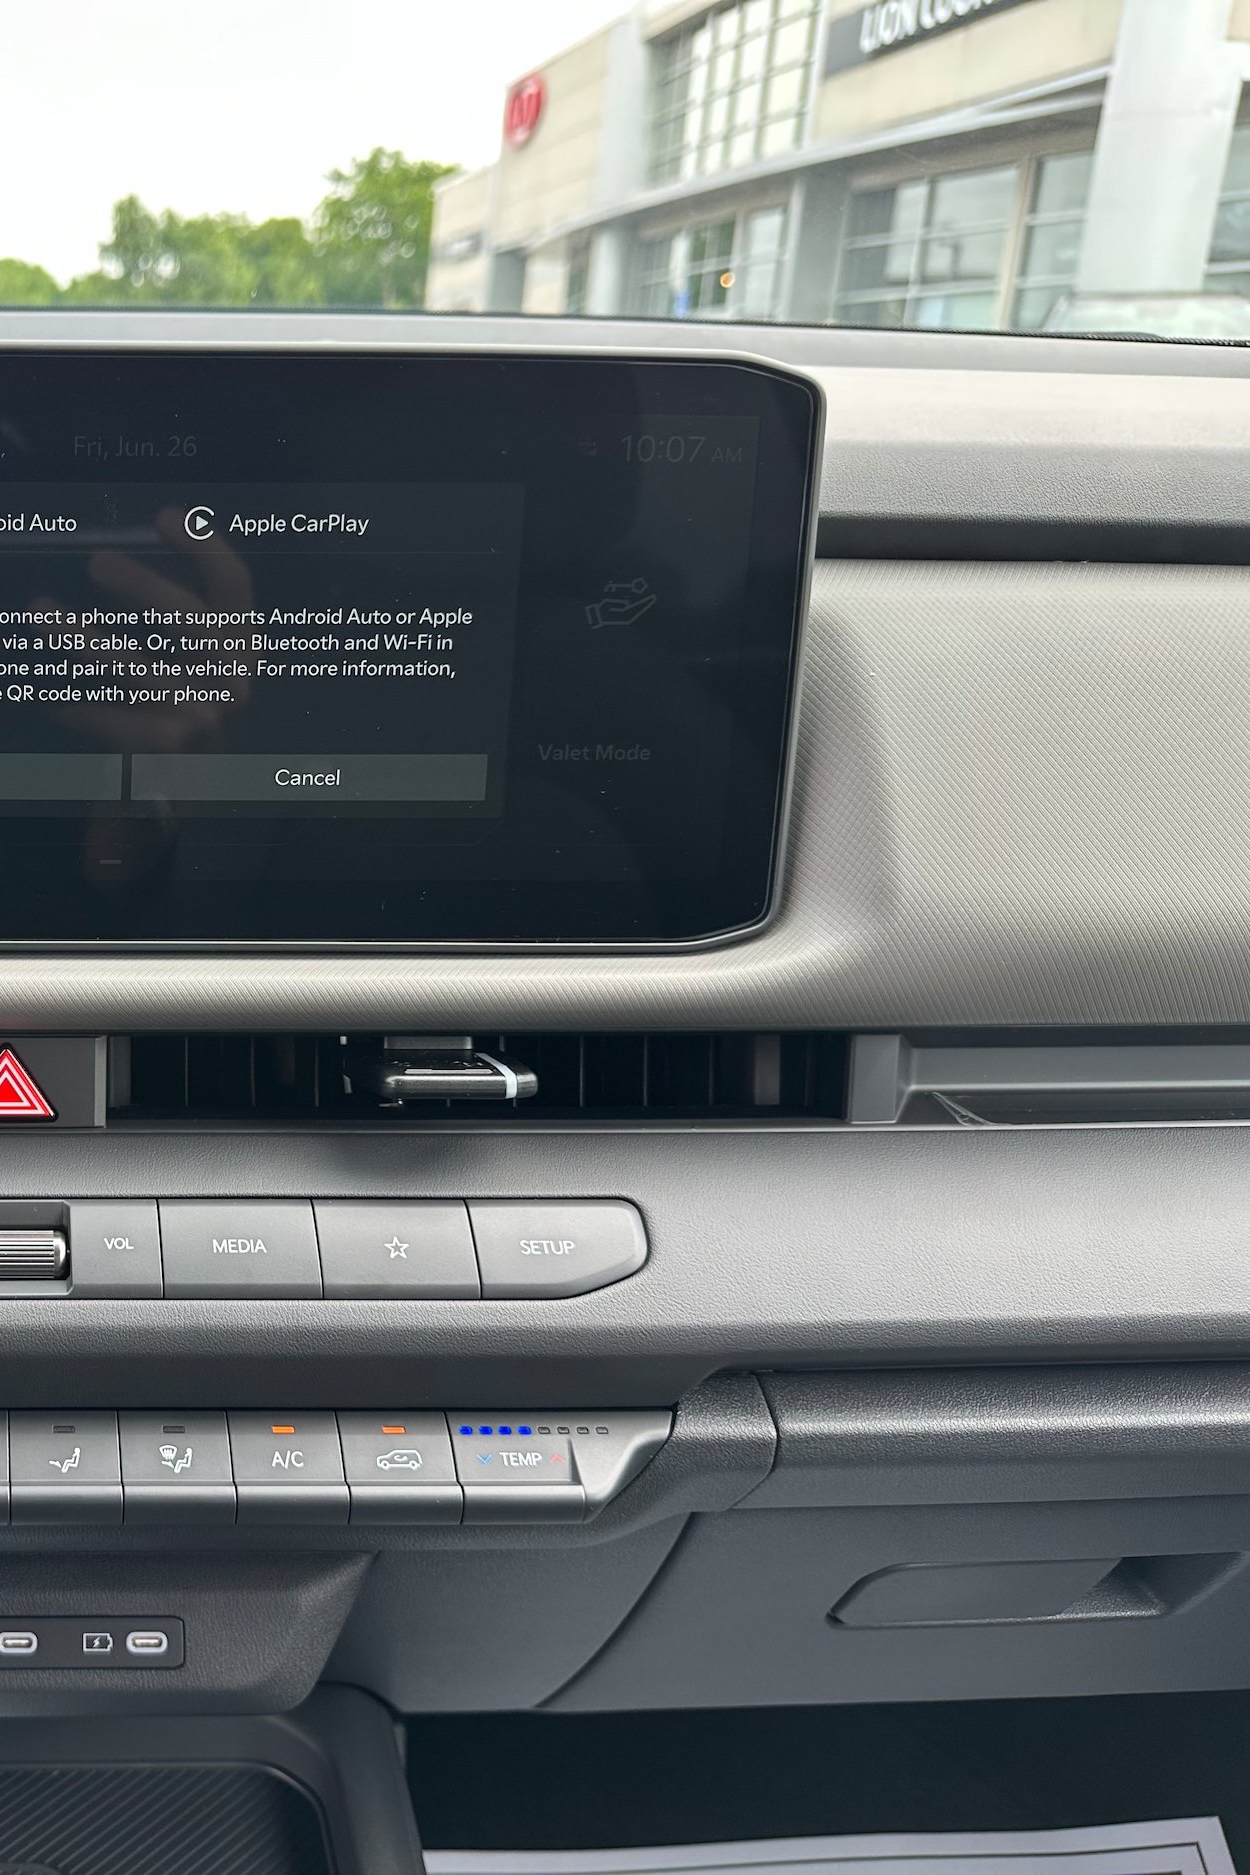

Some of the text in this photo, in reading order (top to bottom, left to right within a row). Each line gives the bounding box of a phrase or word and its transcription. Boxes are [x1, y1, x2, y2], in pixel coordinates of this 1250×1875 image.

[74, 435, 198, 461] Fri, Jun. 26
[620, 434, 743, 463] 10:07 AM
[29, 513, 78, 532] Auto
[228, 513, 370, 537] Apple CarPlay
[65, 612, 77, 625] a
[81, 607, 139, 629] phone
[141, 607, 182, 625] that
[185, 609, 266, 629] supports
[268, 607, 343, 625] Android
[346, 607, 392, 625] Auto
[394, 611, 417, 626] or
[418, 607, 473, 629] Apple
[2, 633, 28, 650] via
[33, 637, 44, 650] a
[48, 633, 86, 651] USB
[89, 633, 143, 651] cable.
[146, 633, 176, 654] Or,
[179, 635, 219, 651] turn
[222, 638, 246, 651] on
[251, 633, 340, 651] Bluetooth
[343, 633, 379, 651] and
[383, 633, 433, 651] Wi-Fi
[436, 634, 453, 651] in
[33, 659, 68, 676] and
[72, 659, 109, 680] pair
[112, 659, 125, 676] it
[127, 661, 148, 677] to
[150, 659, 182, 677] the
[185, 659, 252, 677] vehicle.
[256, 659, 287, 677] For
[290, 664, 338, 677] more
[342, 659, 456, 679] information,
[6, 684, 35, 703] QR
[38, 684, 82, 702] code
[85, 684, 125, 702] with
[128, 689, 171, 705] your
[174, 685, 235, 706] phone.
[538, 743, 652, 761] Valet Mode
[274, 768, 341, 786] Cancel
[103, 1237, 134, 1251] VOL
[212, 1239, 267, 1254] MEDIA
[519, 1239, 575, 1256] SETUP
[271, 1450, 304, 1470] A/C
[498, 1452, 543, 1467] TEMP
